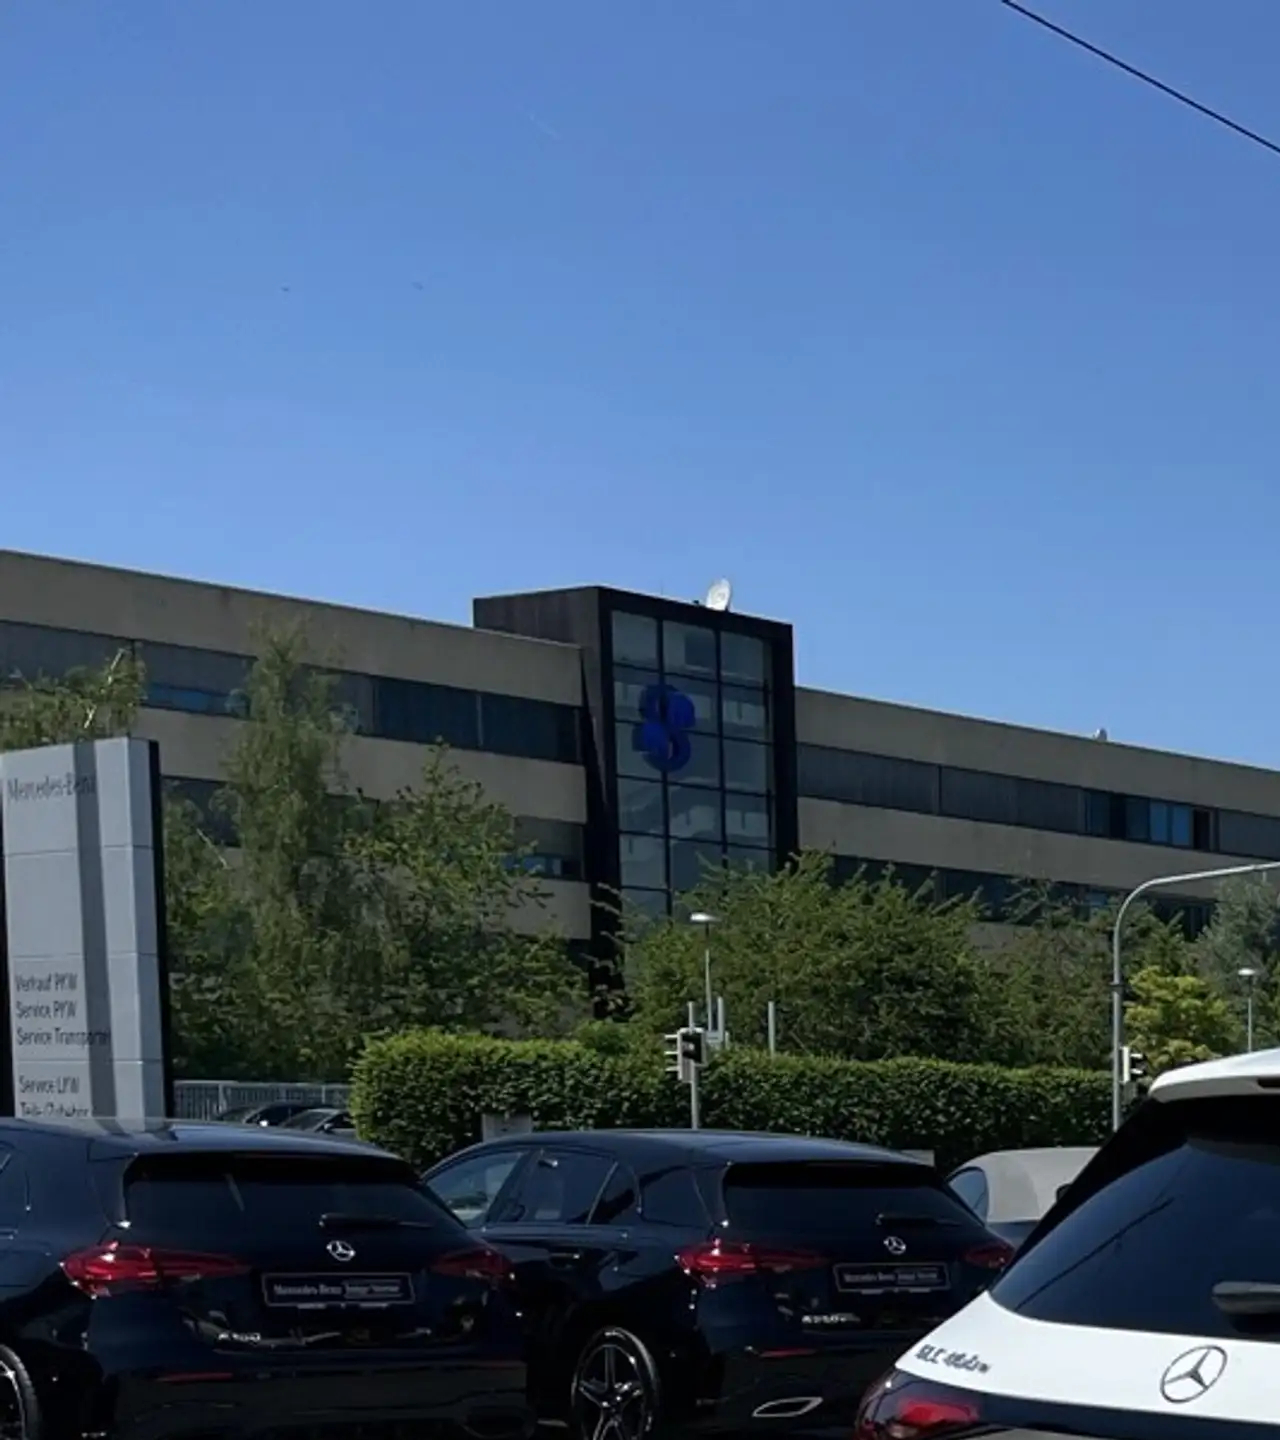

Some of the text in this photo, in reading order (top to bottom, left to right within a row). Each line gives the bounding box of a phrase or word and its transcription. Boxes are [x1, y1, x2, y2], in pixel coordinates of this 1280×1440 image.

[16, 1000, 52, 1019] Service
[17, 1026, 53, 1046] Service
[20, 1074, 56, 1093] Service
